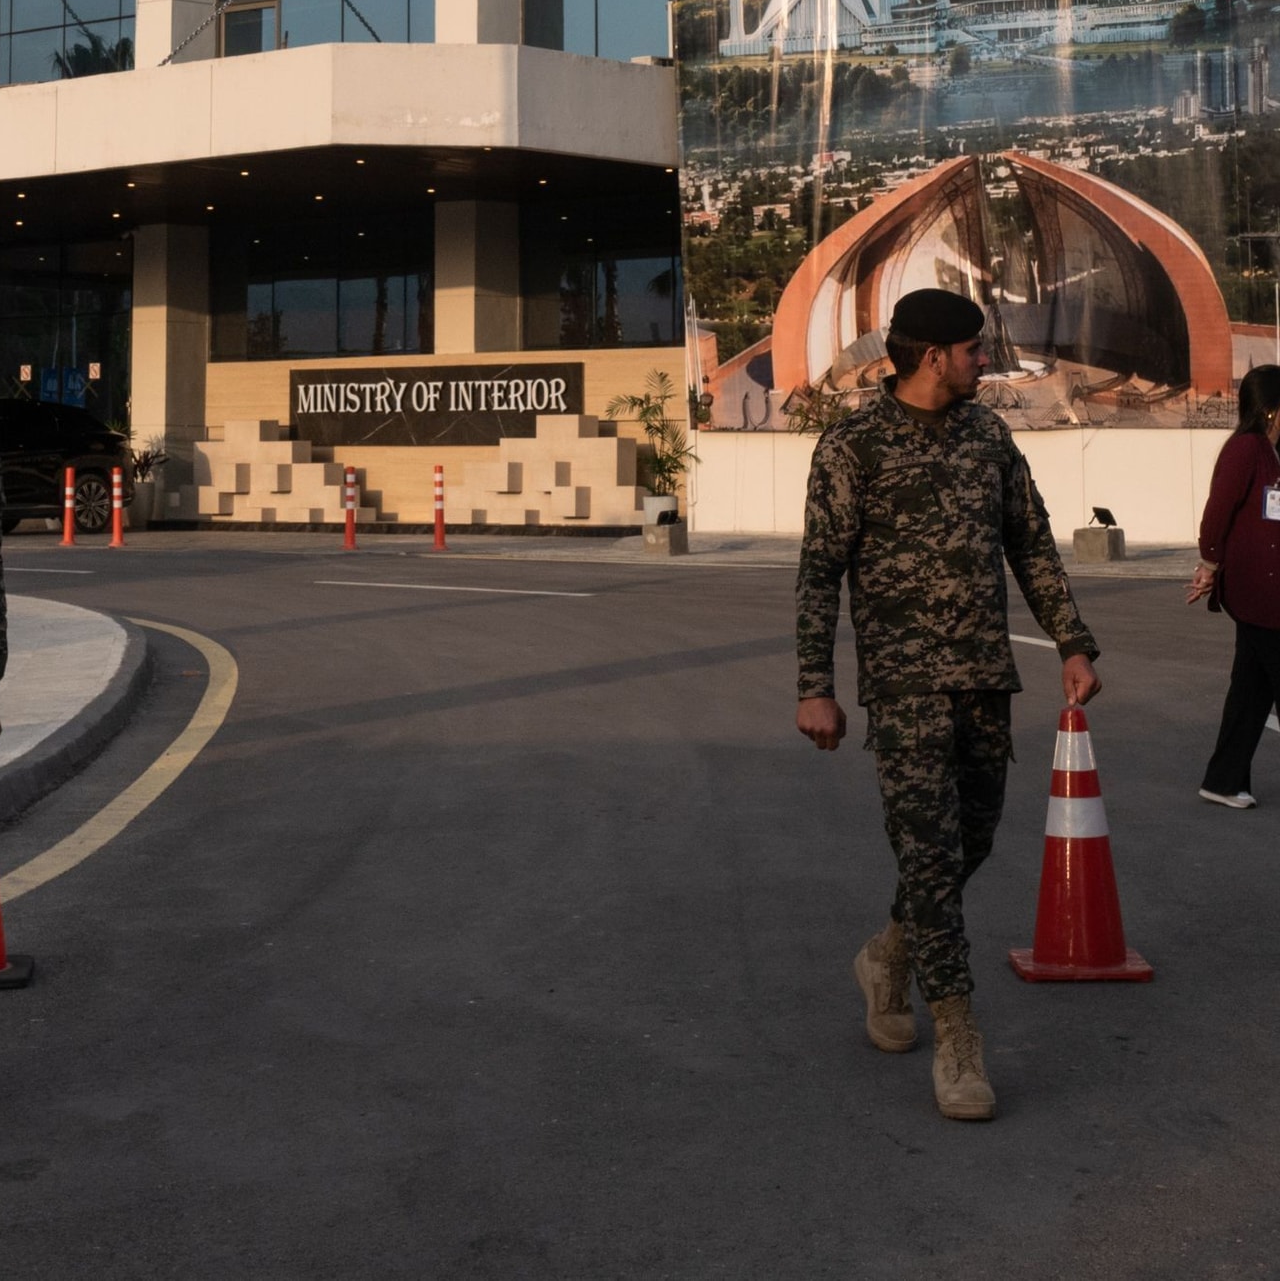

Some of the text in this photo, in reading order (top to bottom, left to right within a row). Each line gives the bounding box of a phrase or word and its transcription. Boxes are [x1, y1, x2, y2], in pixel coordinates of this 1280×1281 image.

[297, 377, 567, 414] MINISTRY OF INTERIOR
